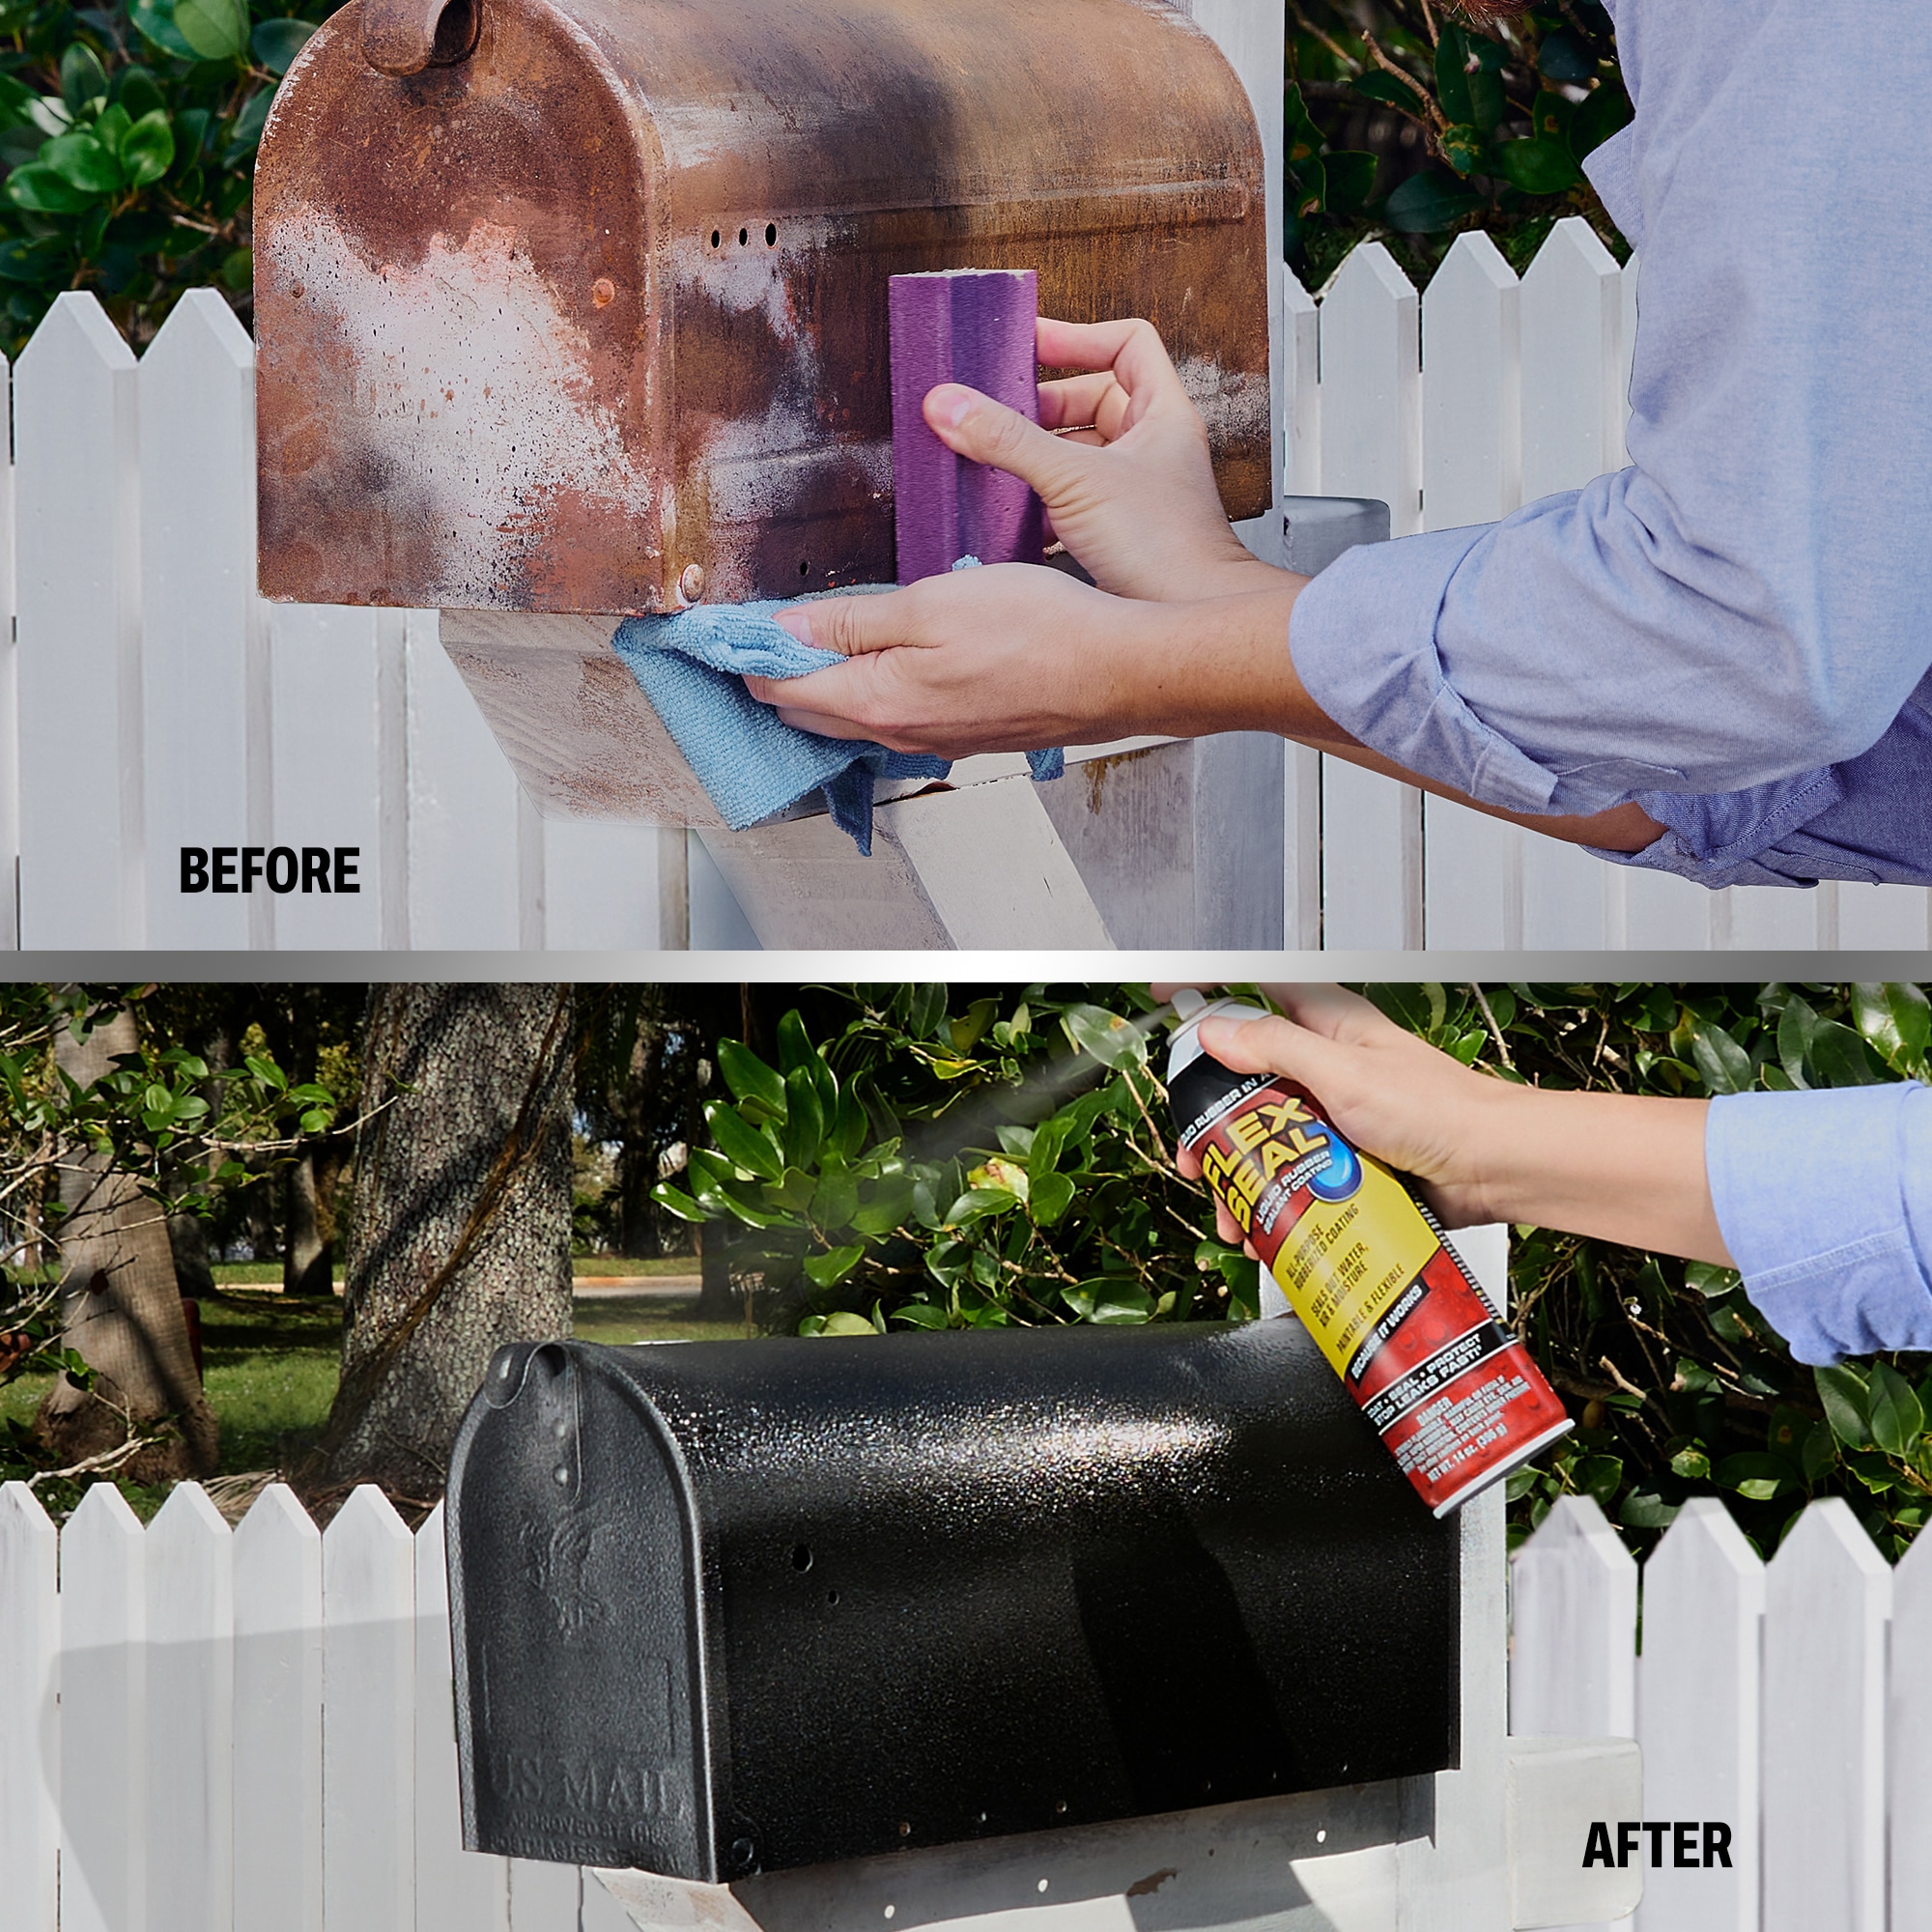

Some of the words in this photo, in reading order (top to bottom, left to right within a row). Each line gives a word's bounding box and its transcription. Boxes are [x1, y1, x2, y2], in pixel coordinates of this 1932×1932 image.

[1195, 1089, 1242, 1129] RUBBER
[1241, 1078, 1257, 1094] IN
[1202, 1097, 1315, 1201] FLEX
[1227, 1127, 1328, 1235] SEAL
[1256, 1184, 1283, 1225] LIQUID
[1280, 1151, 1330, 1187] RUBBER
[1264, 1187, 1293, 1236] SEALANT
[1291, 1158, 1333, 1192] COATING
[1286, 1223, 1325, 1279] ALL-PURPOSE
[1293, 1242, 1328, 1291] RUBBERIZED
[1325, 1203, 1359, 1244] COATING
[1311, 1289, 1329, 1318] SEALS
[1324, 1272, 1342, 1295] OUT
[1337, 1241, 1370, 1278] WATER,
[1319, 1308, 1331, 1329] AIR
[1327, 1303, 1337, 1317] &
[1331, 1261, 1369, 1308] MOISTURE
[1336, 1307, 1368, 1354] PAINTABLE
[1363, 1300, 1375, 1315] &
[1370, 1264, 1406, 1305] FLEXIBLE
[1351, 1333, 1382, 1379] BECAUSE
[1378, 1321, 1390, 1339] IT
[1386, 1285, 1423, 1327] WORKS
[1388, 1377, 1419, 1401] SEAL
[1426, 1333, 1481, 1374] PROTECT
[1374, 1405, 1395, 1427] STOP
[1395, 1375, 1439, 1409] LEAKS
[1416, 1396, 1453, 1427] DANGER
